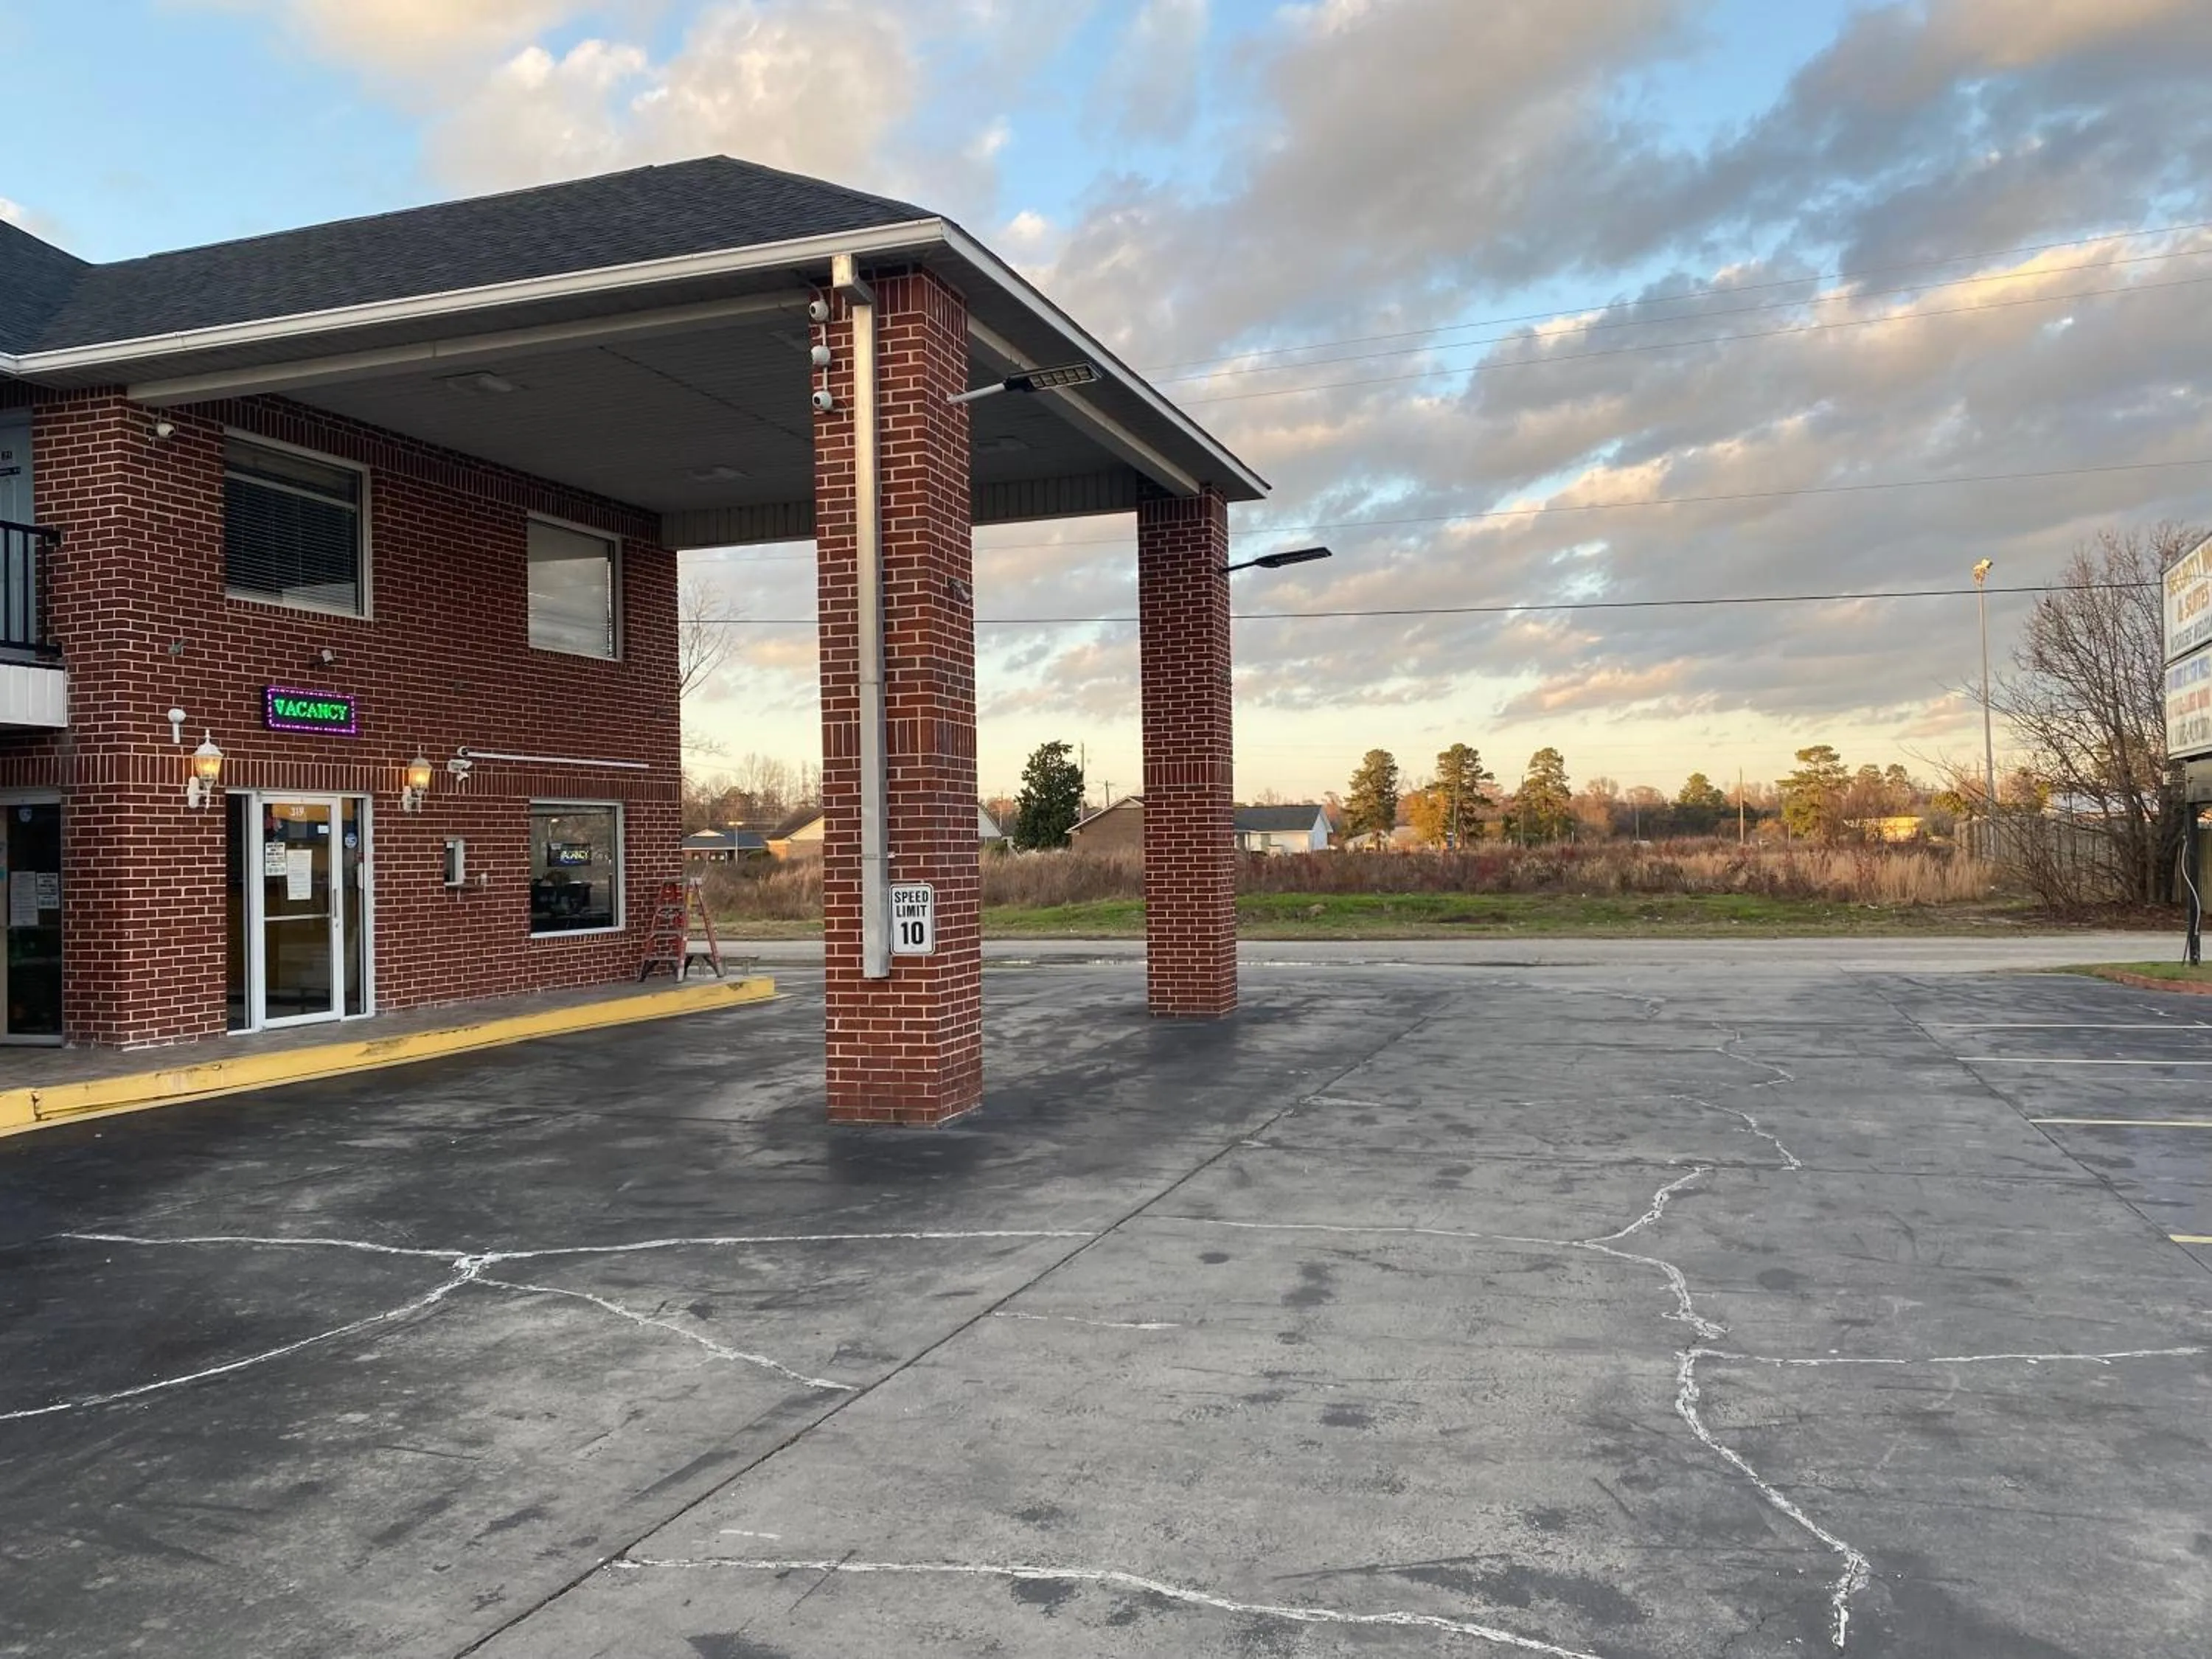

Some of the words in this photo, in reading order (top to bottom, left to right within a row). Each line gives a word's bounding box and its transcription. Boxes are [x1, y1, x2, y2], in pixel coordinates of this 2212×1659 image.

[274, 698, 349, 720] VACANCY
[894, 891, 928, 903] SPEED
[896, 905, 927, 918] LIMIT
[900, 921, 924, 945] 10
